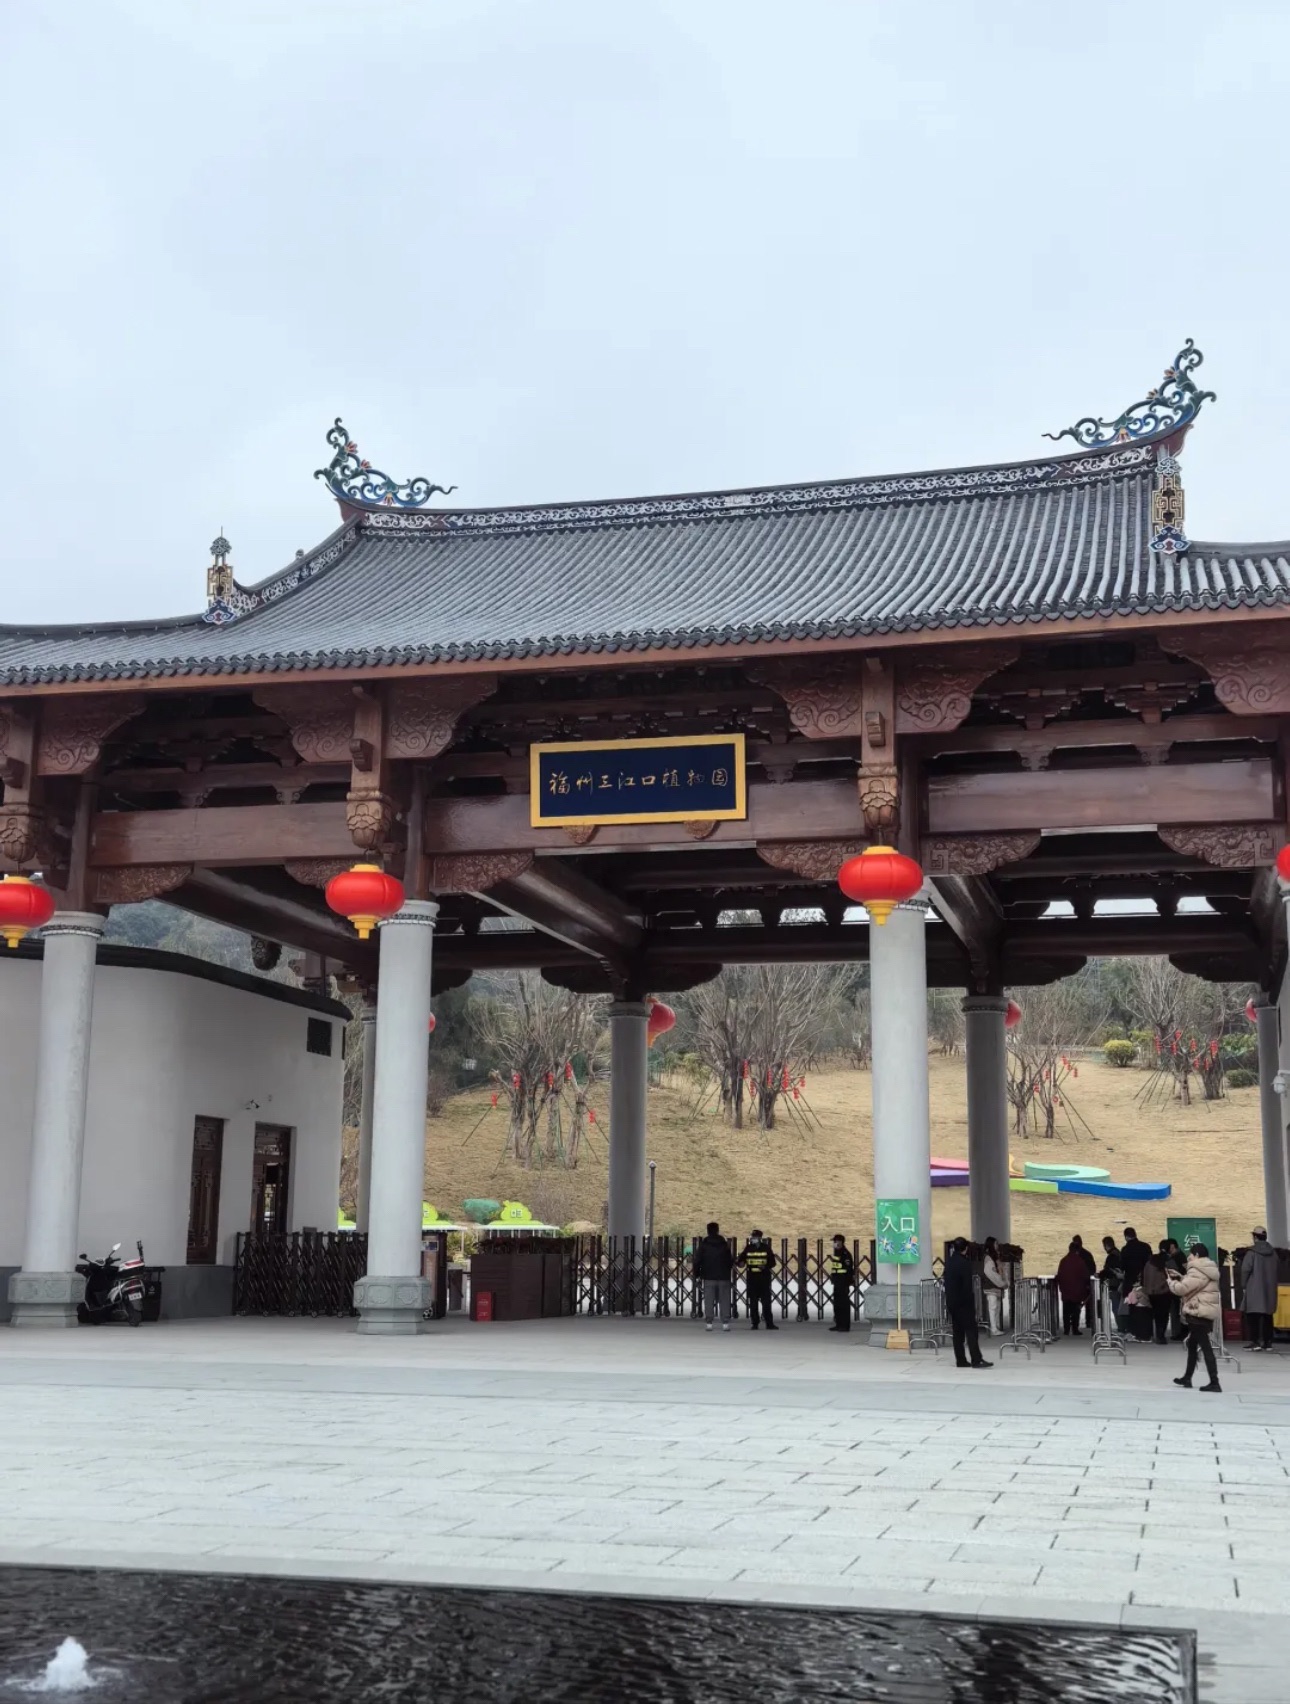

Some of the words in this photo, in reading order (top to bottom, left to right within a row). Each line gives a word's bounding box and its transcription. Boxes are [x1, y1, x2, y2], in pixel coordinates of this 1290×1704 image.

[549, 768, 728, 795] 福州三江口植物园
[882, 1216, 915, 1232] 入口
